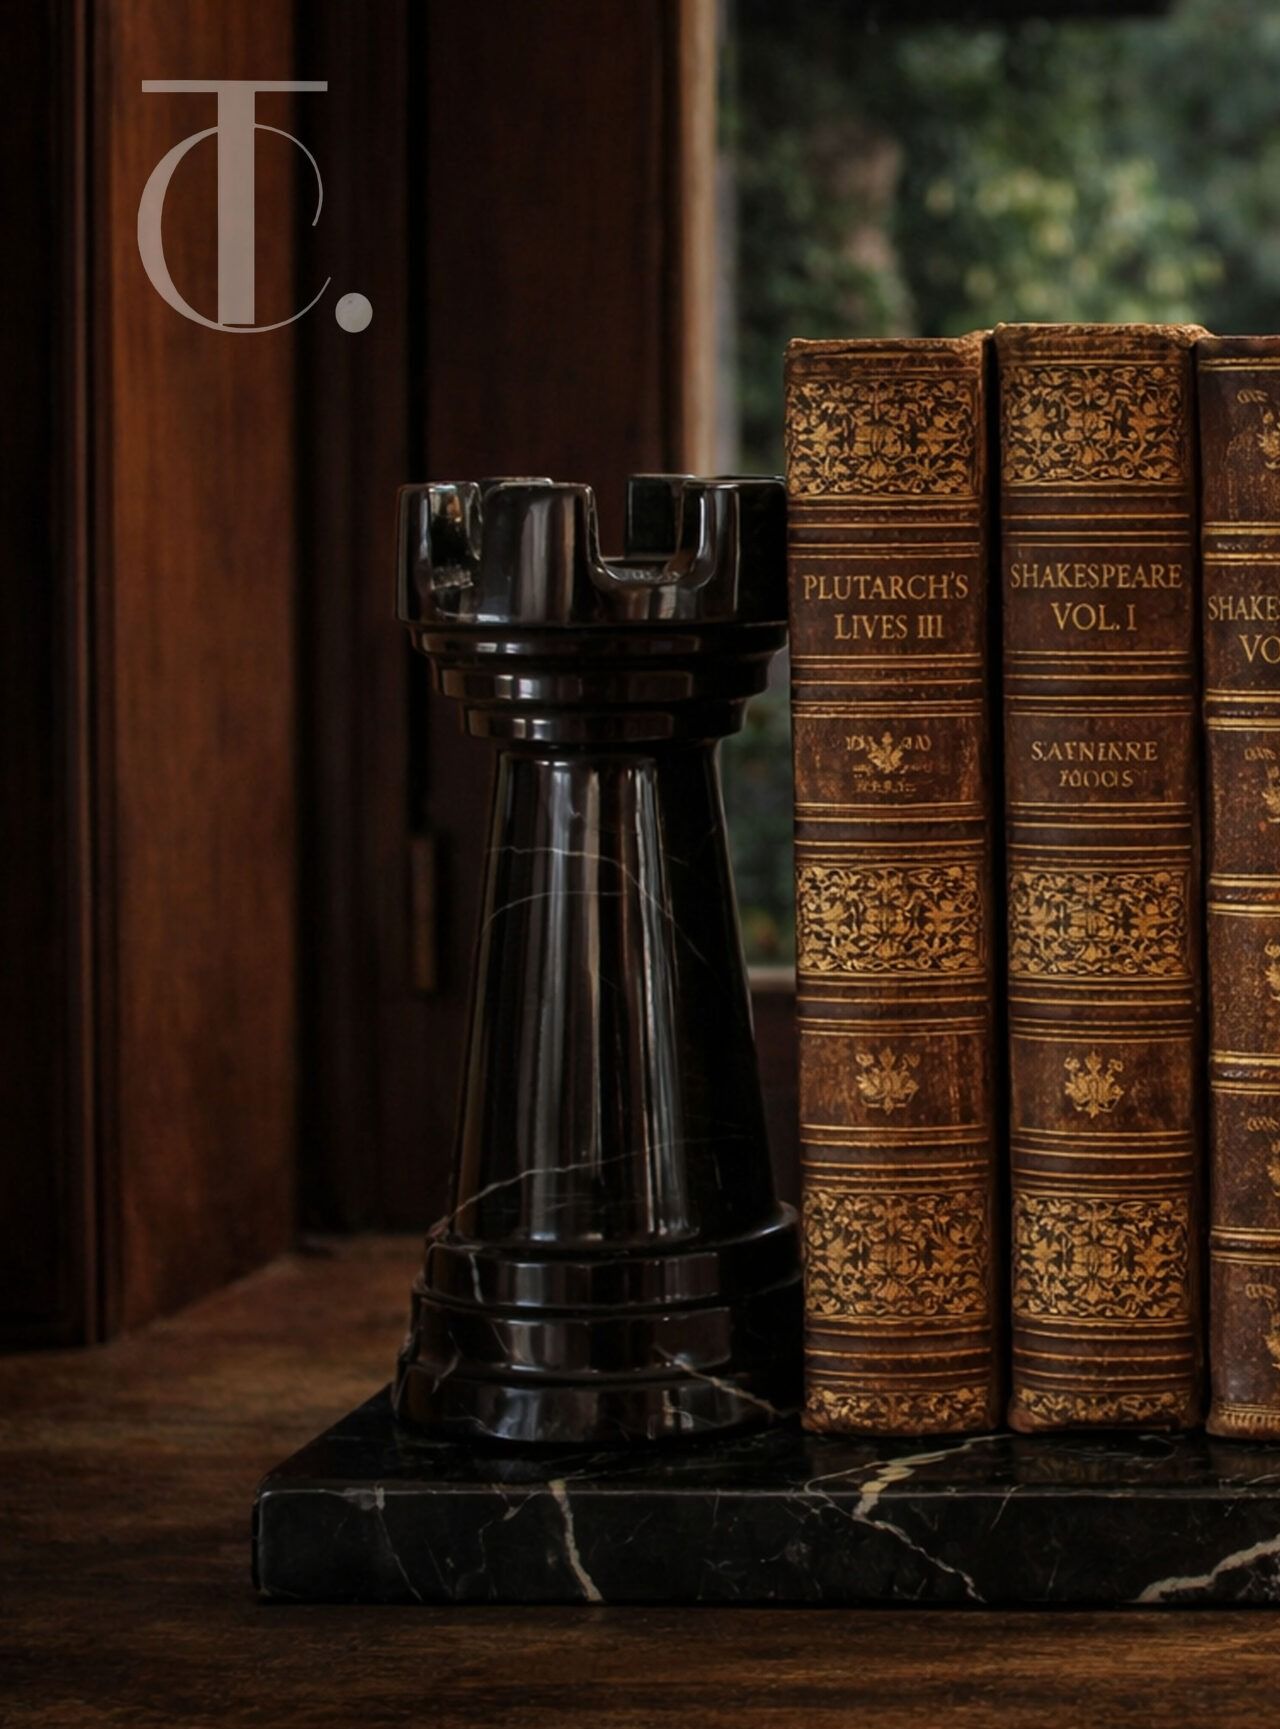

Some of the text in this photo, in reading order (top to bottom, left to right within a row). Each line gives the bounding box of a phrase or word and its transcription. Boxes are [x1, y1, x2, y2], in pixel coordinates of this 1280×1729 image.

[803, 571, 968, 600] PLUTARCH'S
[1010, 563, 1183, 589] SHAKESPEARE
[834, 613, 944, 639] LIVES III
[1051, 603, 1138, 630] VOL. I
